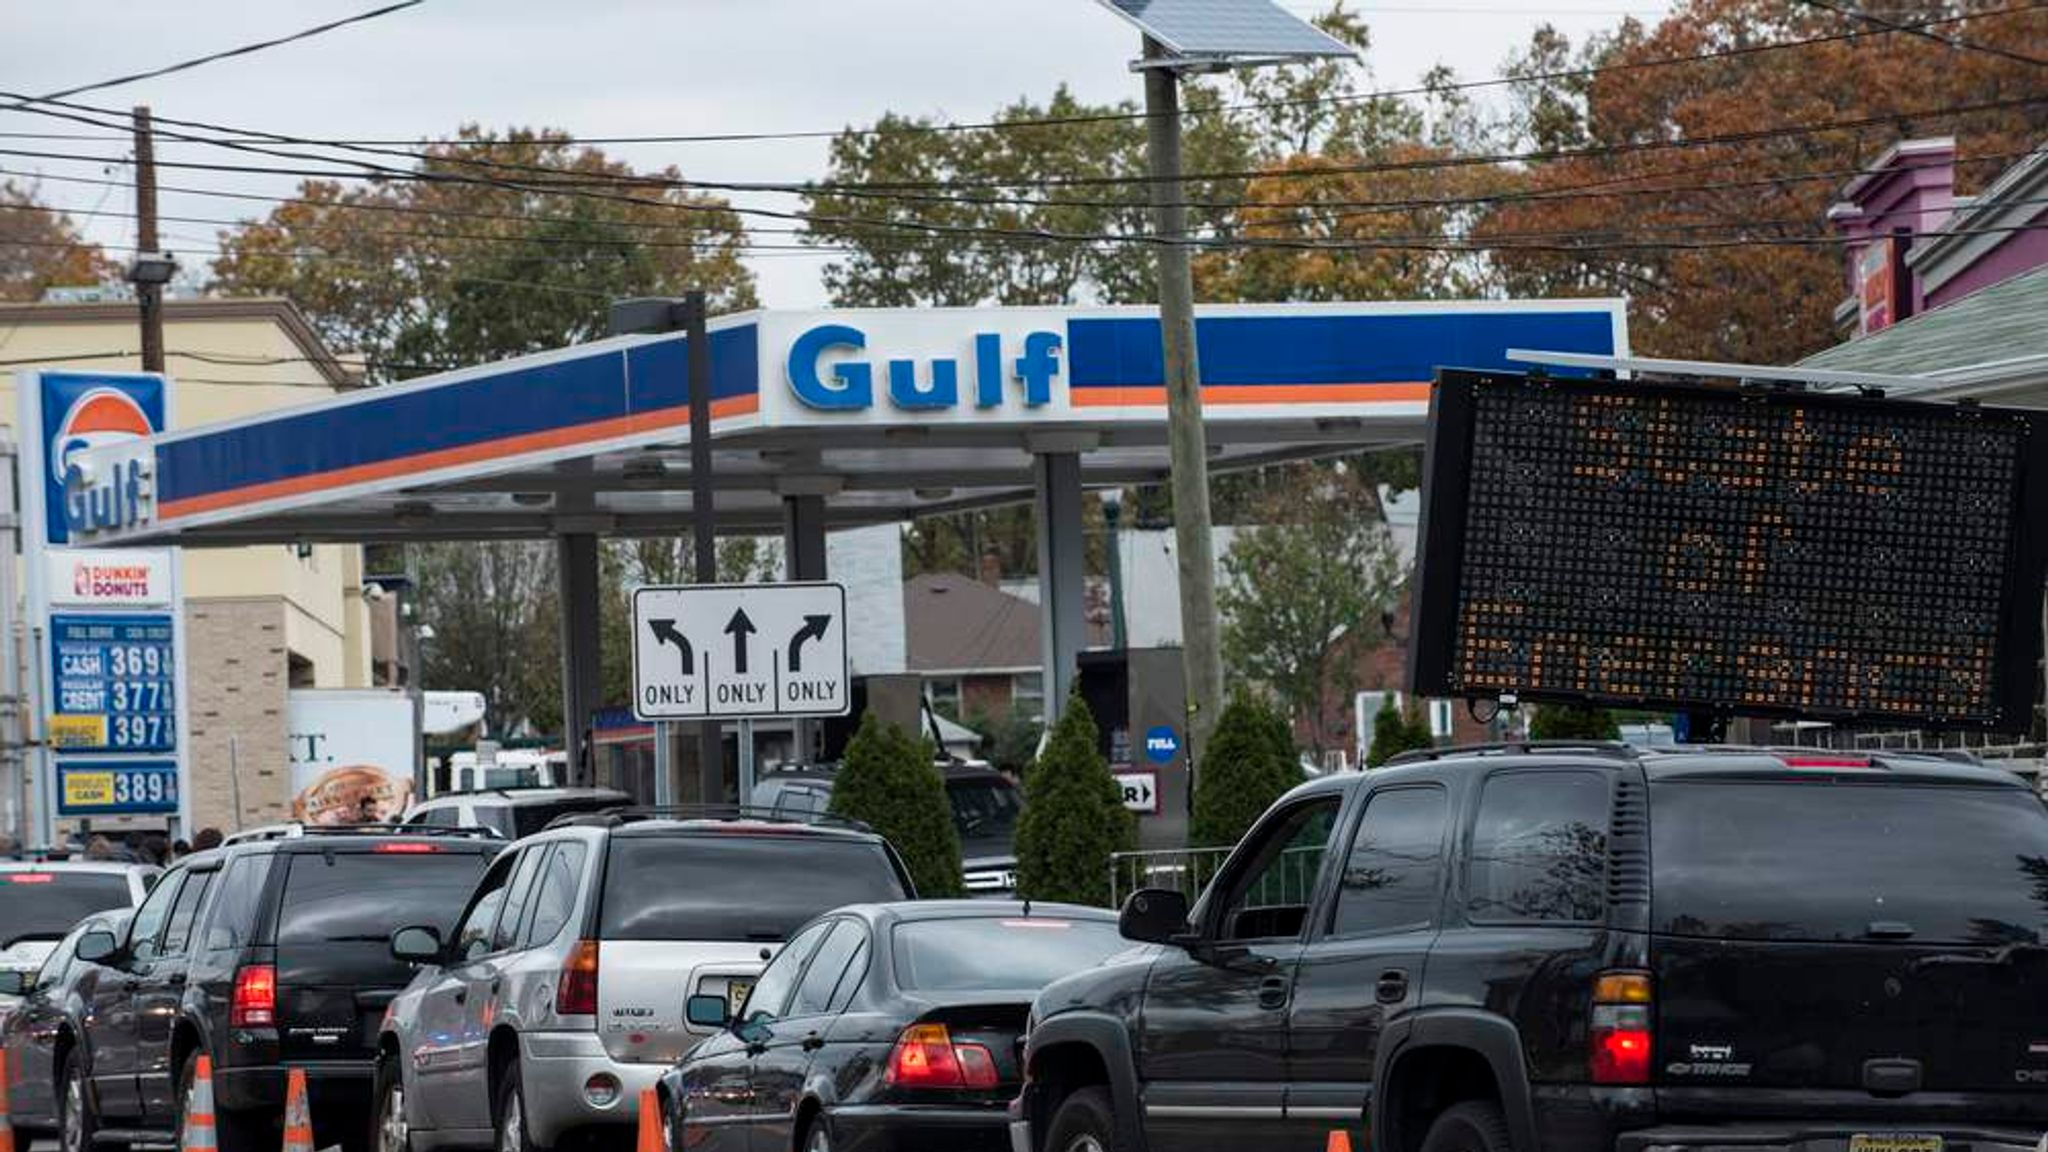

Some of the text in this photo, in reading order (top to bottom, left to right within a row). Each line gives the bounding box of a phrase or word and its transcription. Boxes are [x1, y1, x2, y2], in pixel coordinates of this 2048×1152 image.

[786, 324, 1062, 413] Gulf
[1573, 393, 1903, 495] State
[1666, 512, 1795, 593] of
[93, 582, 148, 596] DONUTS
[61, 656, 101, 675] CASH
[110, 647, 160, 676] 369
[113, 682, 160, 710] 377
[645, 685, 695, 705] ONLY
[717, 683, 767, 703] ONLY
[788, 680, 837, 701] ONLY
[115, 716, 161, 745] 397
[289, 733, 334, 763] T.
[116, 773, 162, 802] 389
